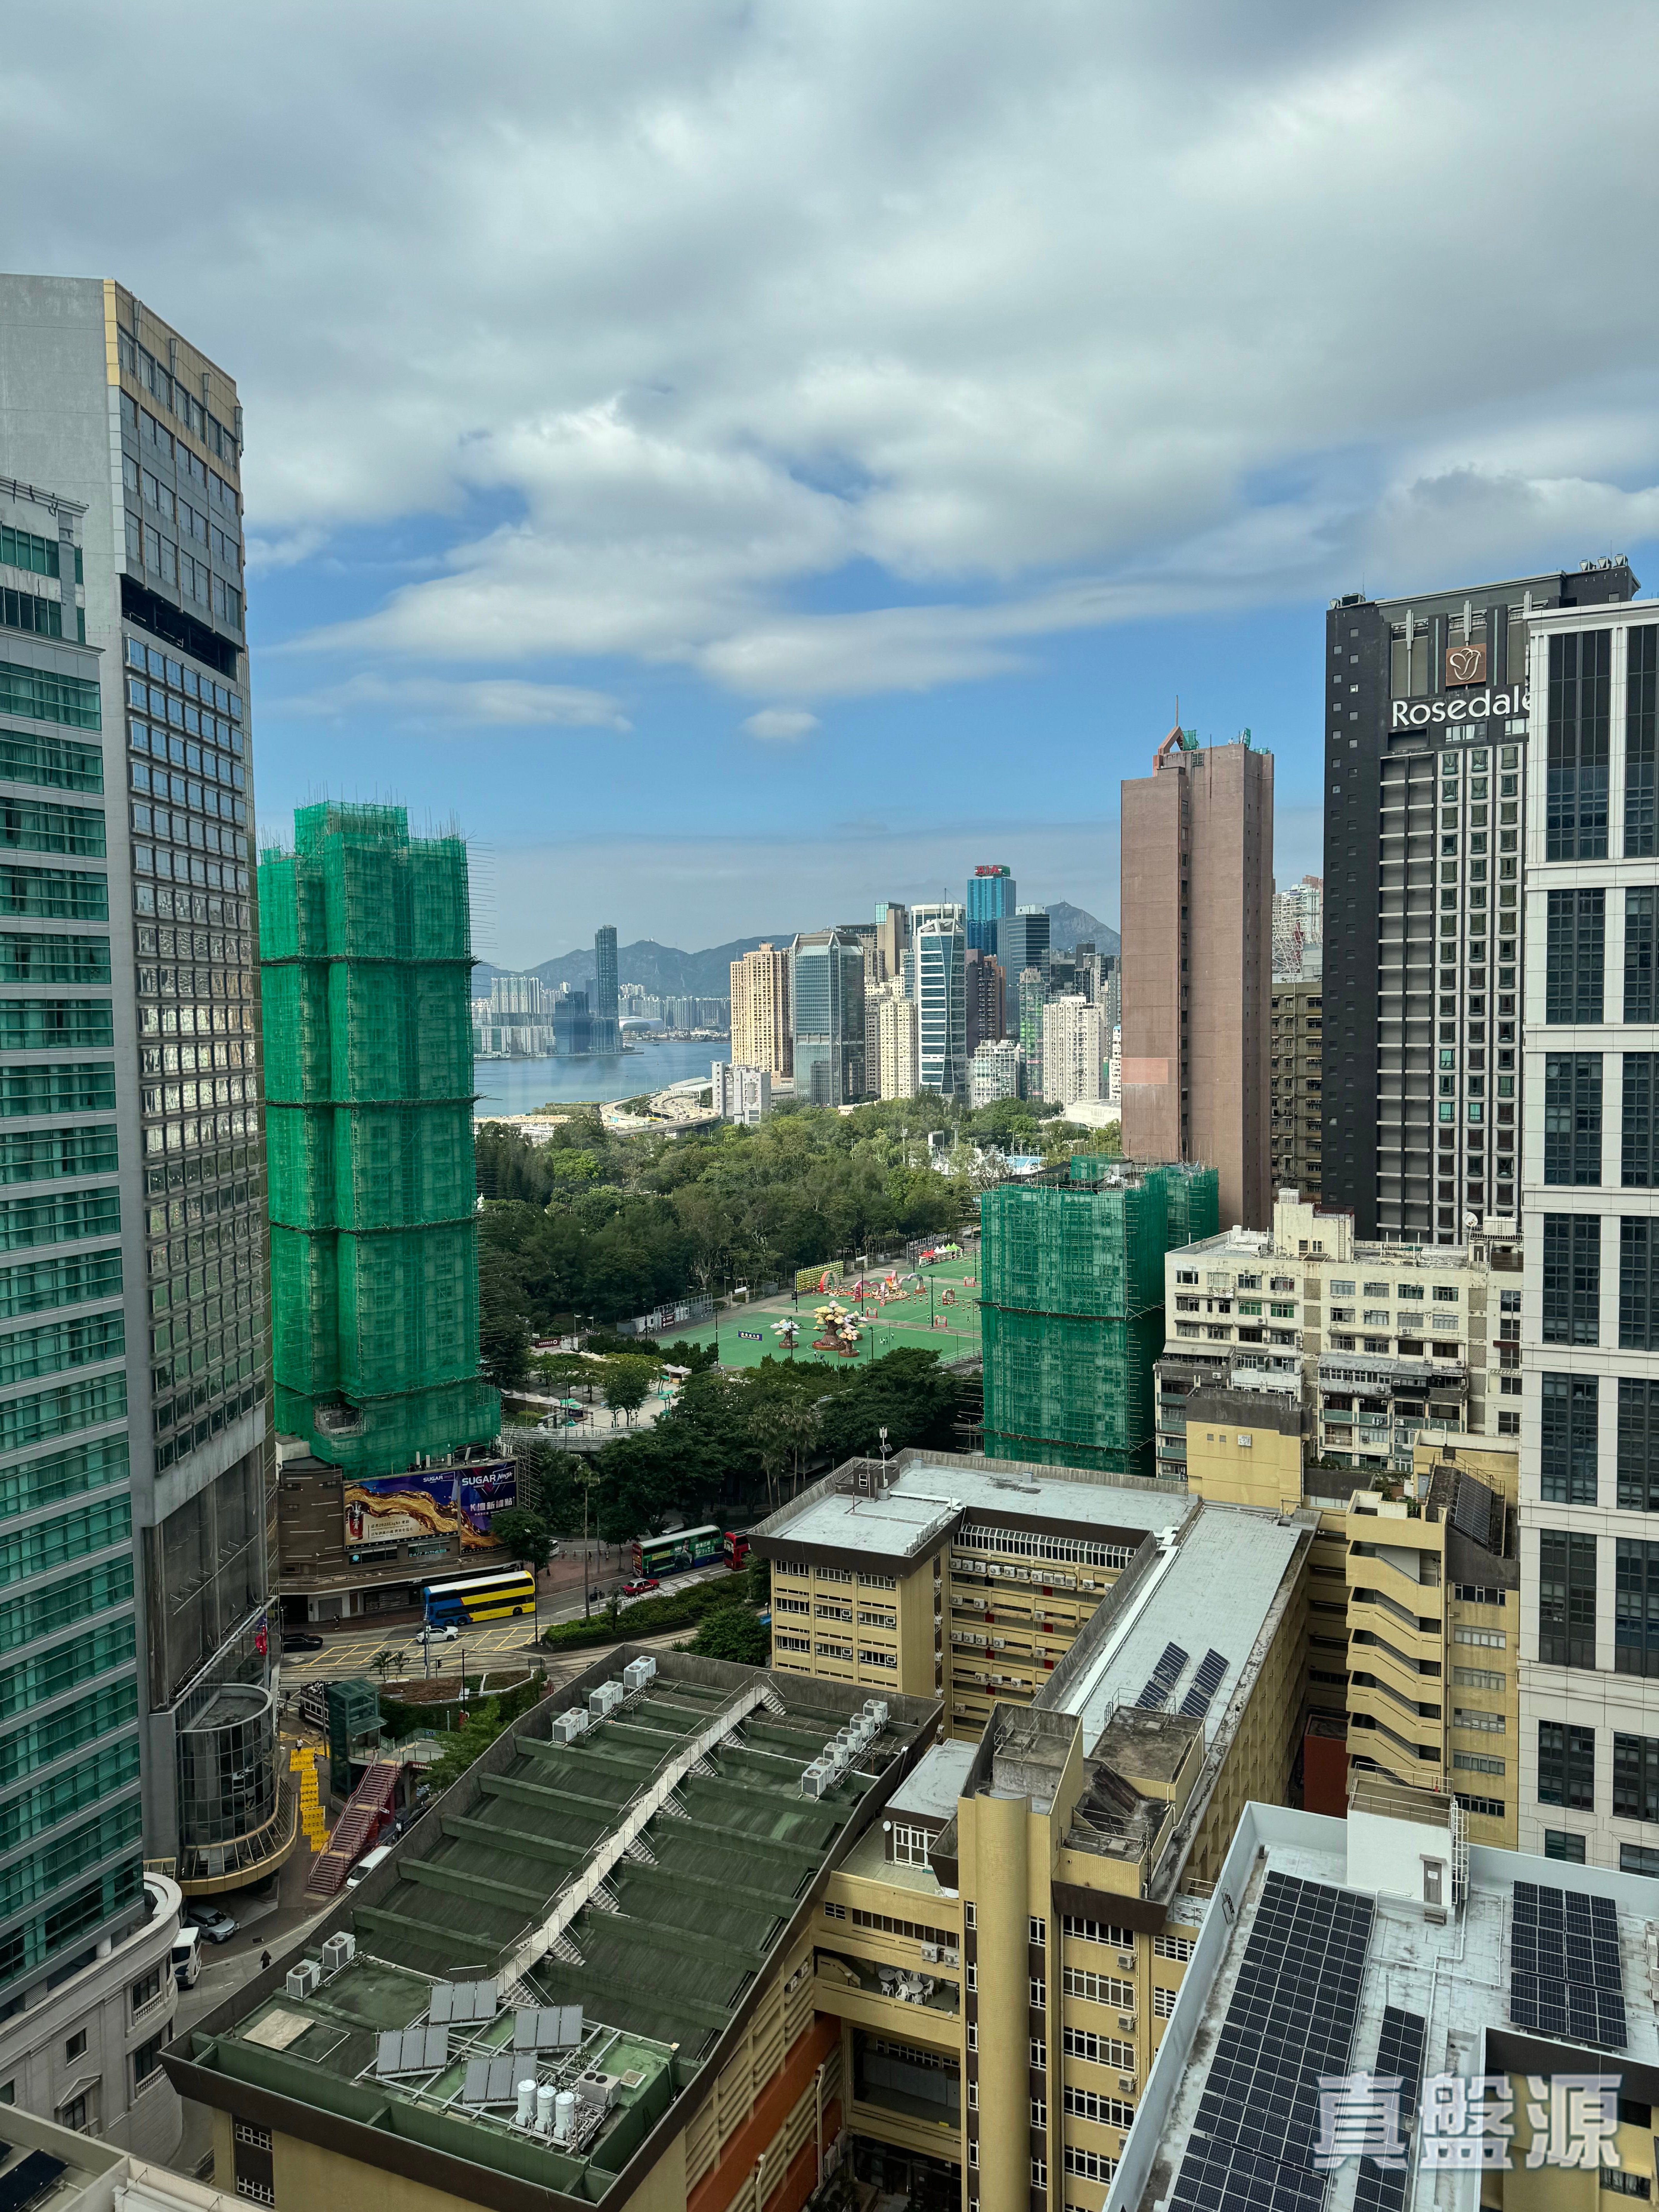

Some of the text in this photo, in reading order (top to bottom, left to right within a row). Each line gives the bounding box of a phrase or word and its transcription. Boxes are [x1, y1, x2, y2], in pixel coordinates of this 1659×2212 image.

[976, 866, 999, 874] AIA
[462, 1474, 496, 1486] SUGAR
[498, 1472, 513, 1481] NINJA
